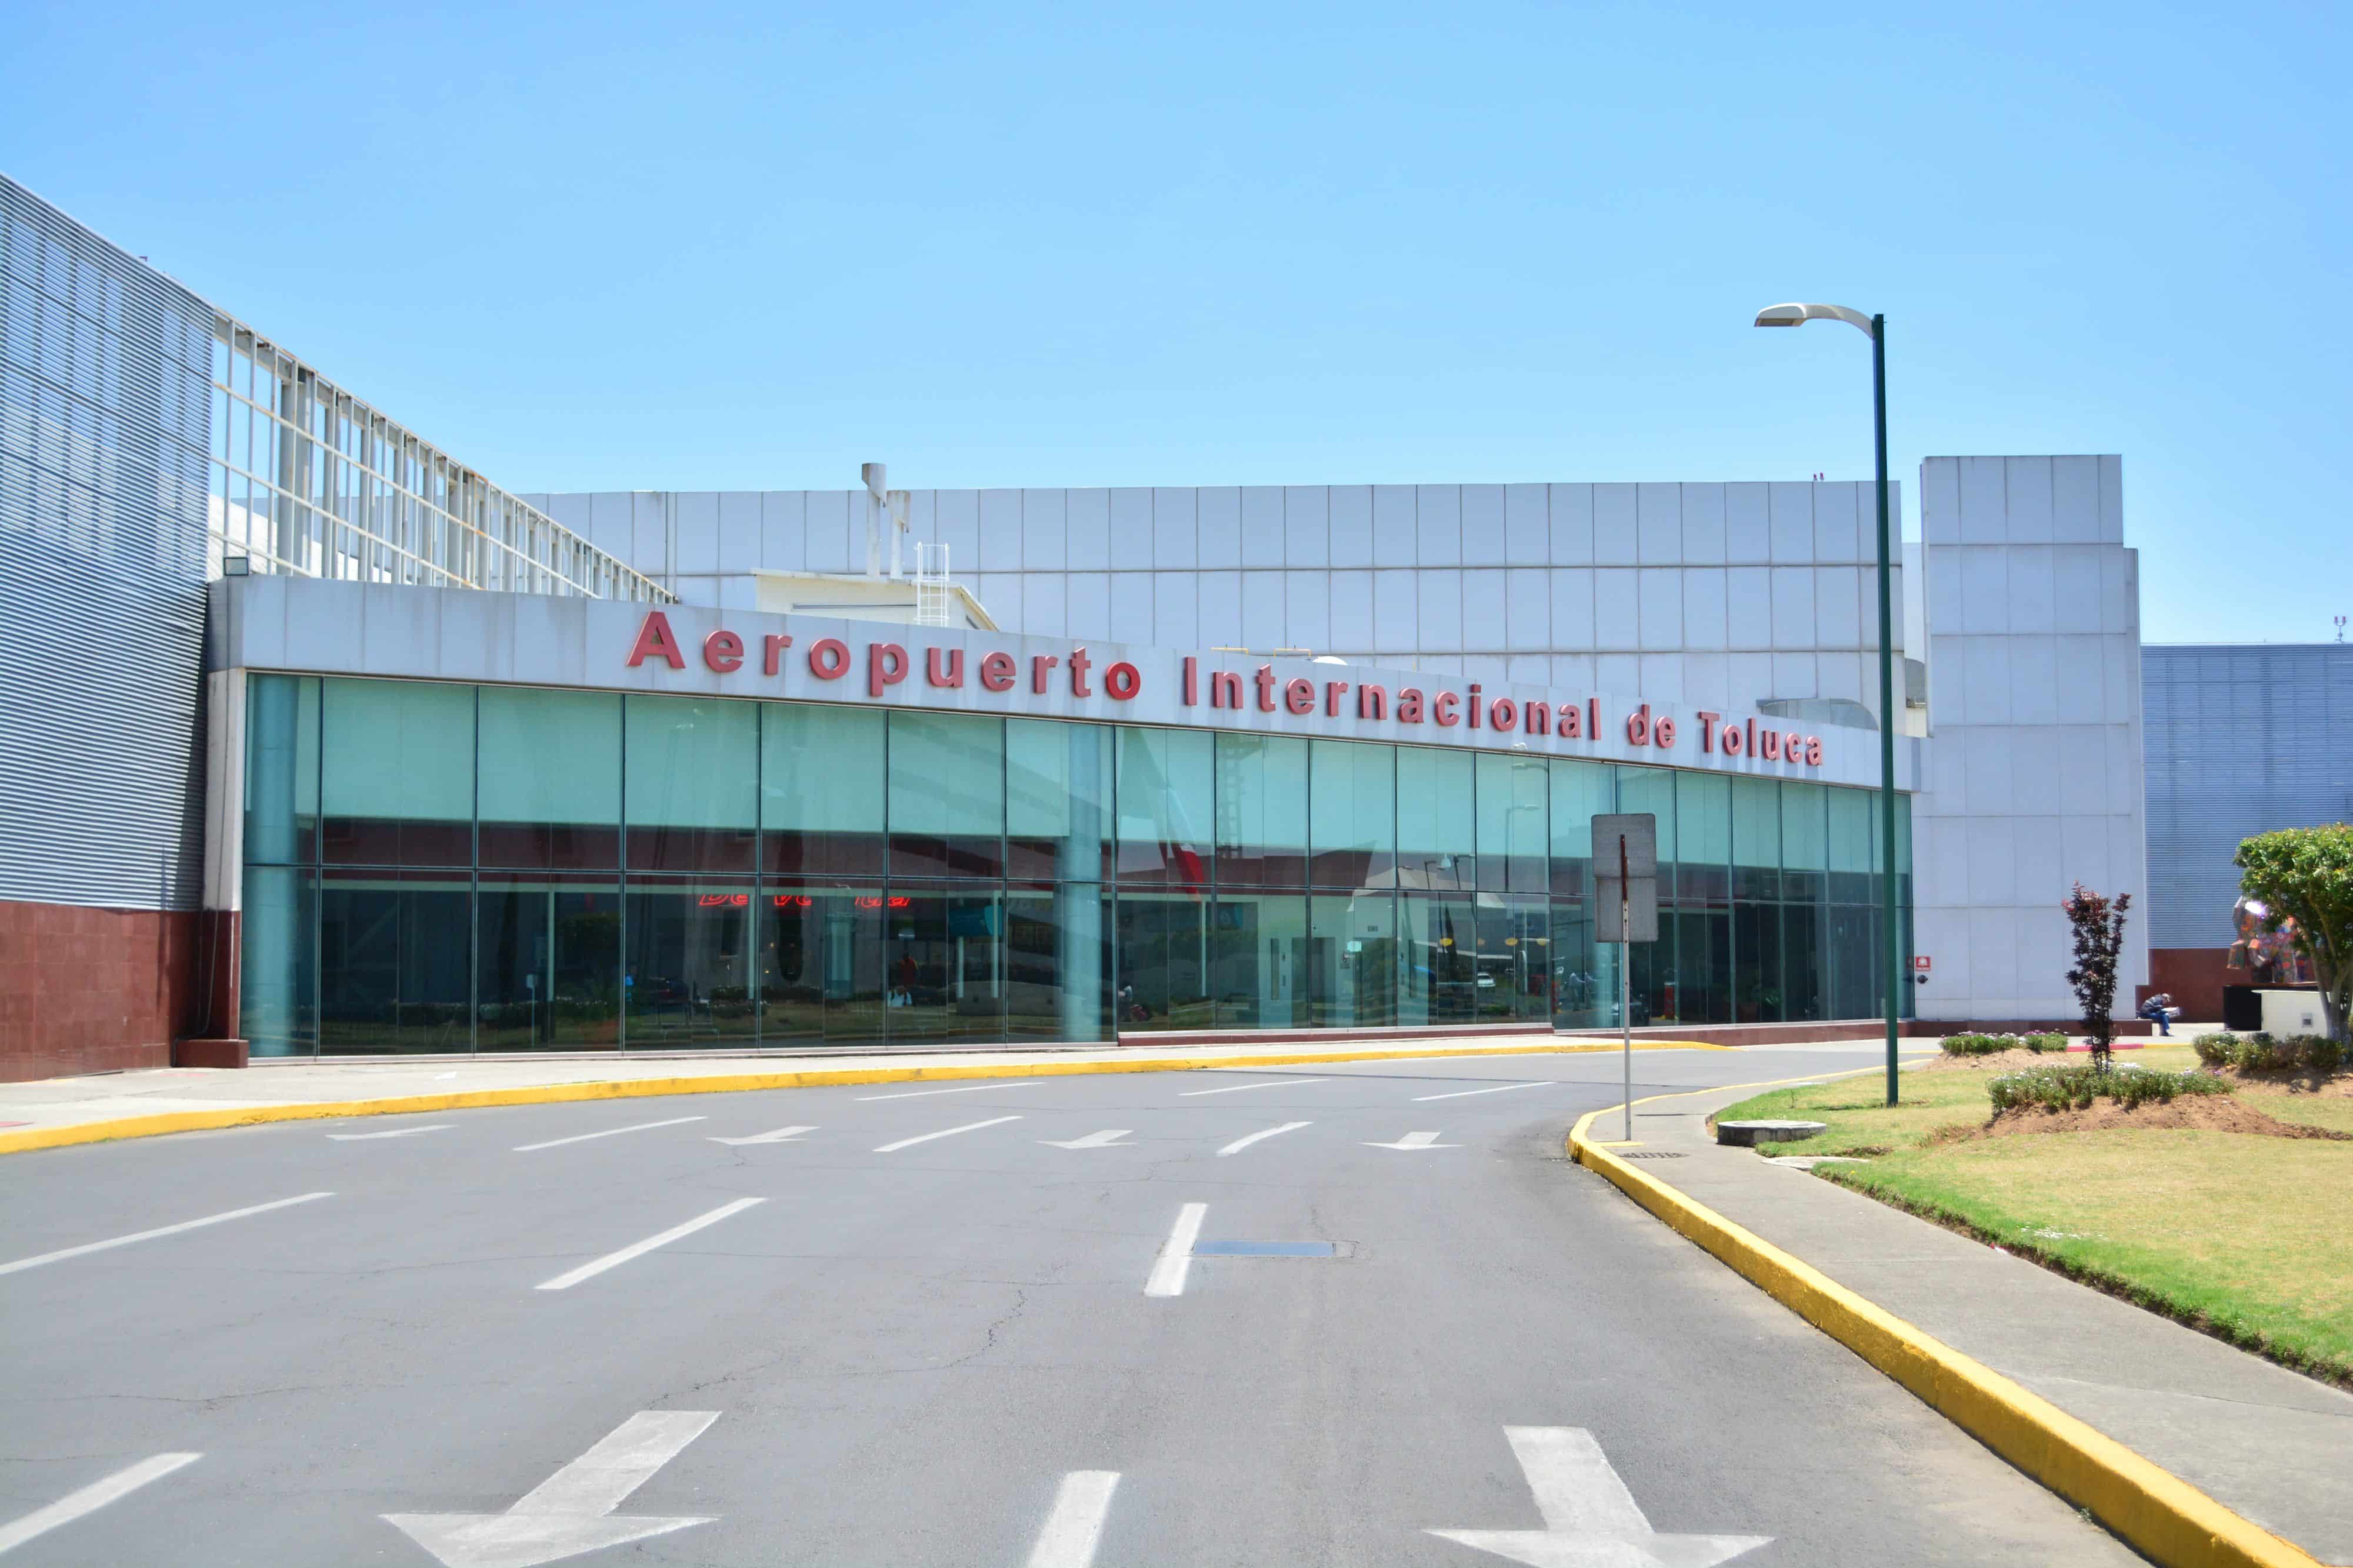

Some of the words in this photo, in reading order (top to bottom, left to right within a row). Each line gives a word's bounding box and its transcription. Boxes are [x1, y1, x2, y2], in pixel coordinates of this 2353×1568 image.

[626, 611, 1141, 700] Aeropuerto
[1184, 656, 1601, 740] Internacional
[1627, 705, 1676, 749] de
[1698, 711, 1822, 765] Toluca
